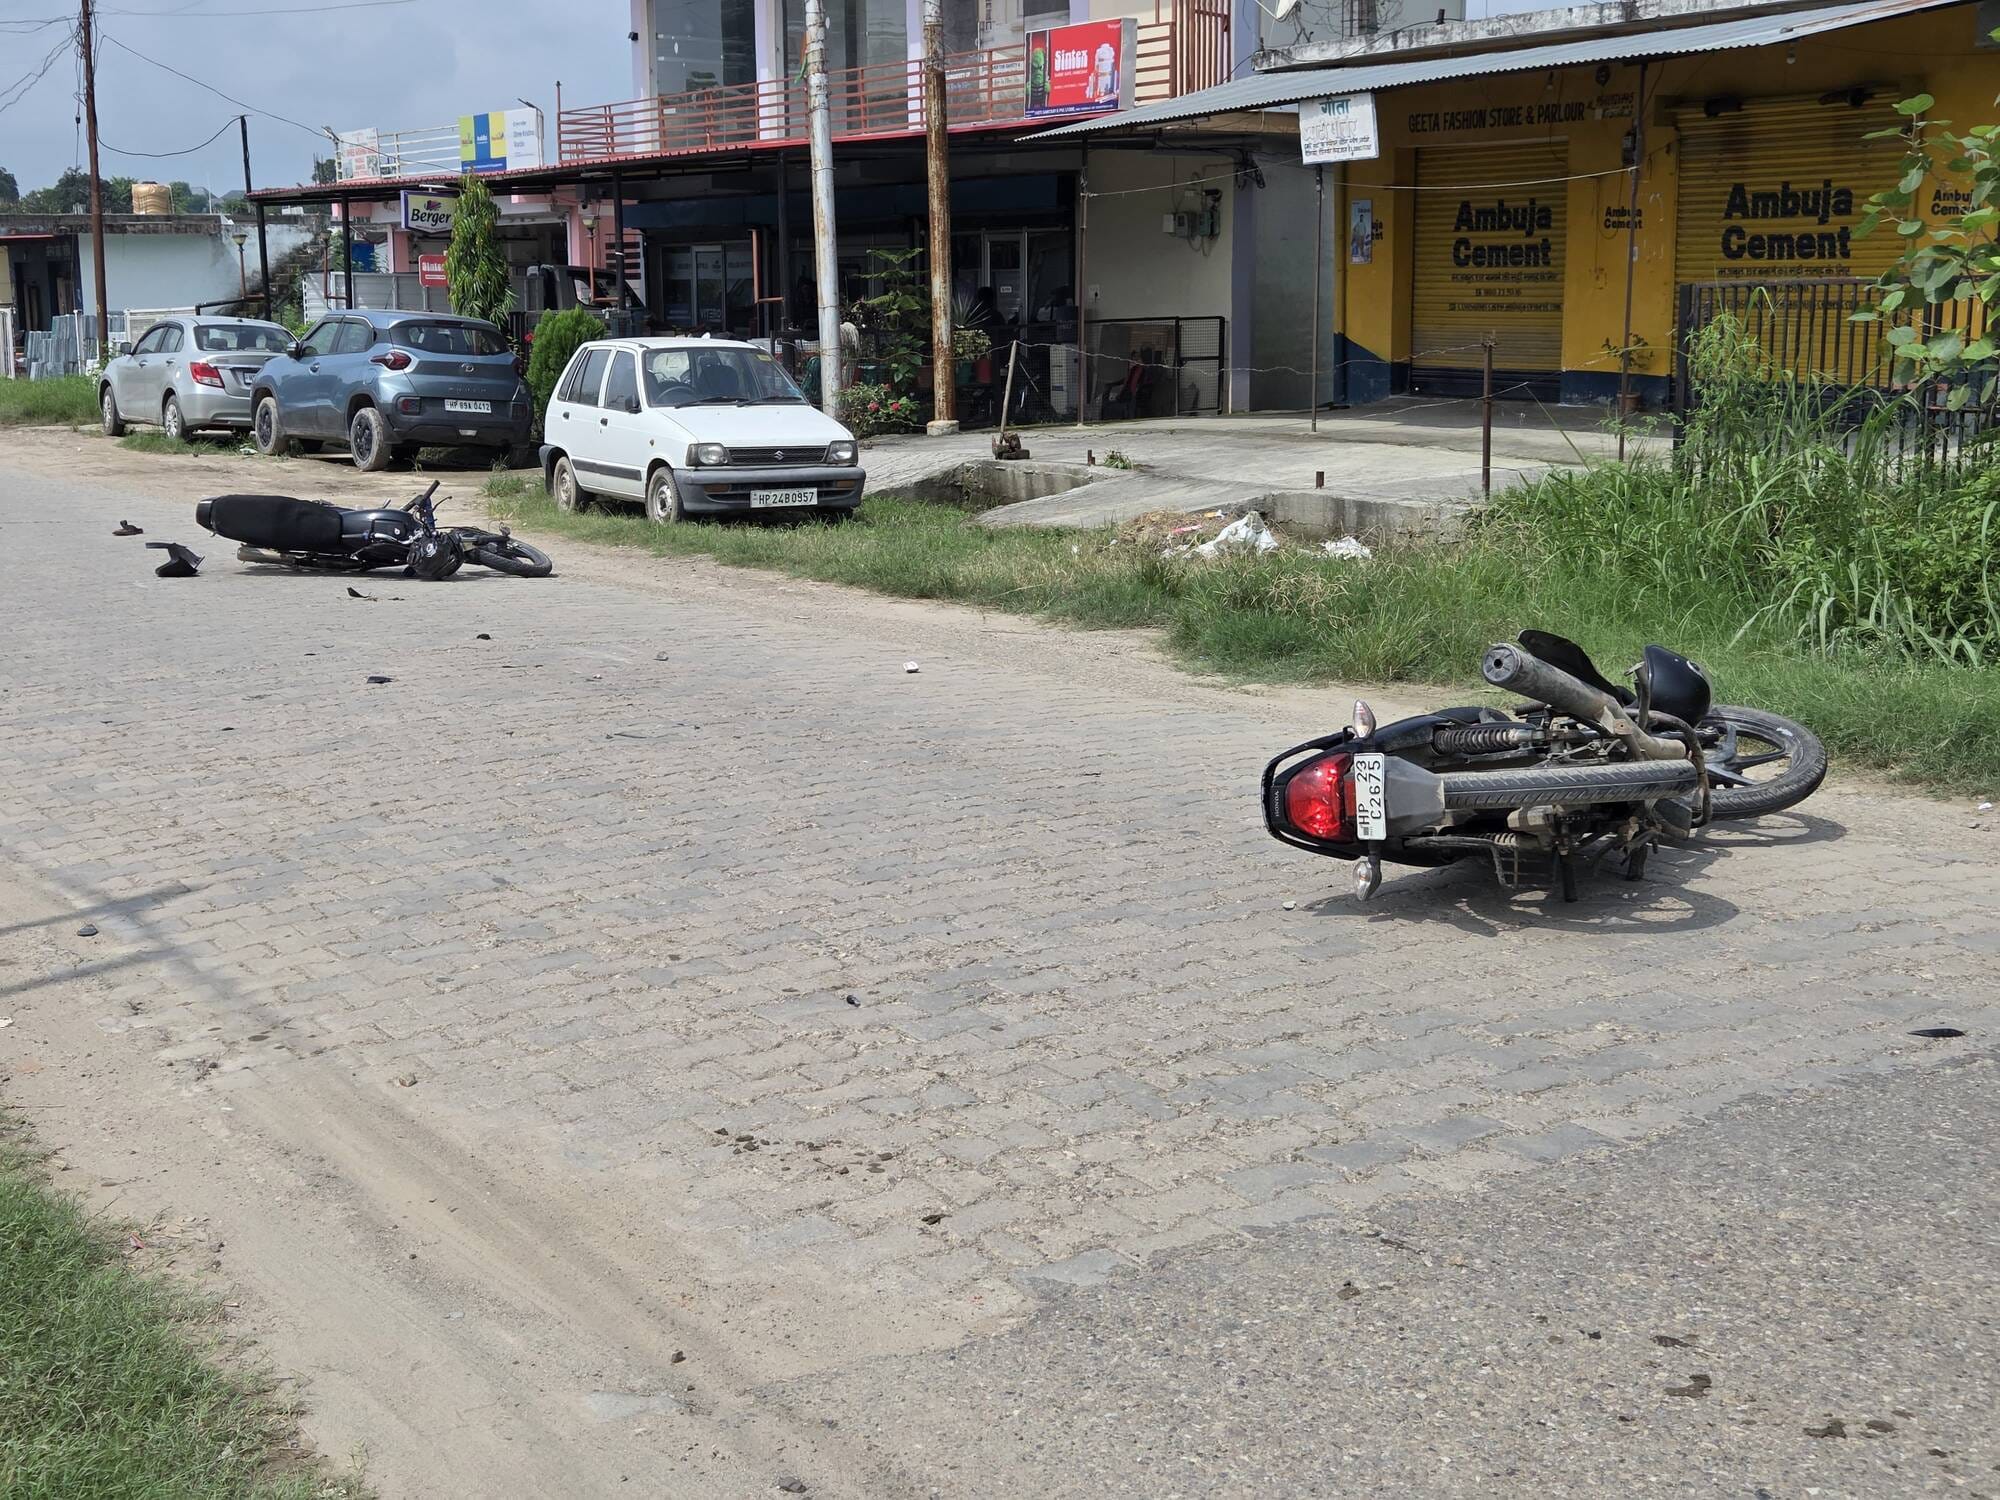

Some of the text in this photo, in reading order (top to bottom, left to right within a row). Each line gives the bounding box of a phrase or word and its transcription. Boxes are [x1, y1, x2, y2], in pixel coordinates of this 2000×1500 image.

[1054, 49, 1088, 72] Sintex
[1319, 97, 1351, 116] गीता
[1408, 112, 1440, 133] GEETA
[1443, 109, 1486, 130] FASHION
[1489, 106, 1523, 128] STORE
[1527, 105, 1535, 125] &
[1537, 102, 1585, 124] PARLOUR
[1723, 179, 1853, 225] Ambuja
[1932, 189, 1974, 204] Ambuj
[411, 208, 452, 227] Berger
[1452, 198, 1552, 237] Ambuja
[1452, 237, 1551, 267] Cement
[1721, 225, 1851, 260] Cement
[1355, 760, 1370, 825] HP 23
[1367, 760, 1382, 819] C2675
